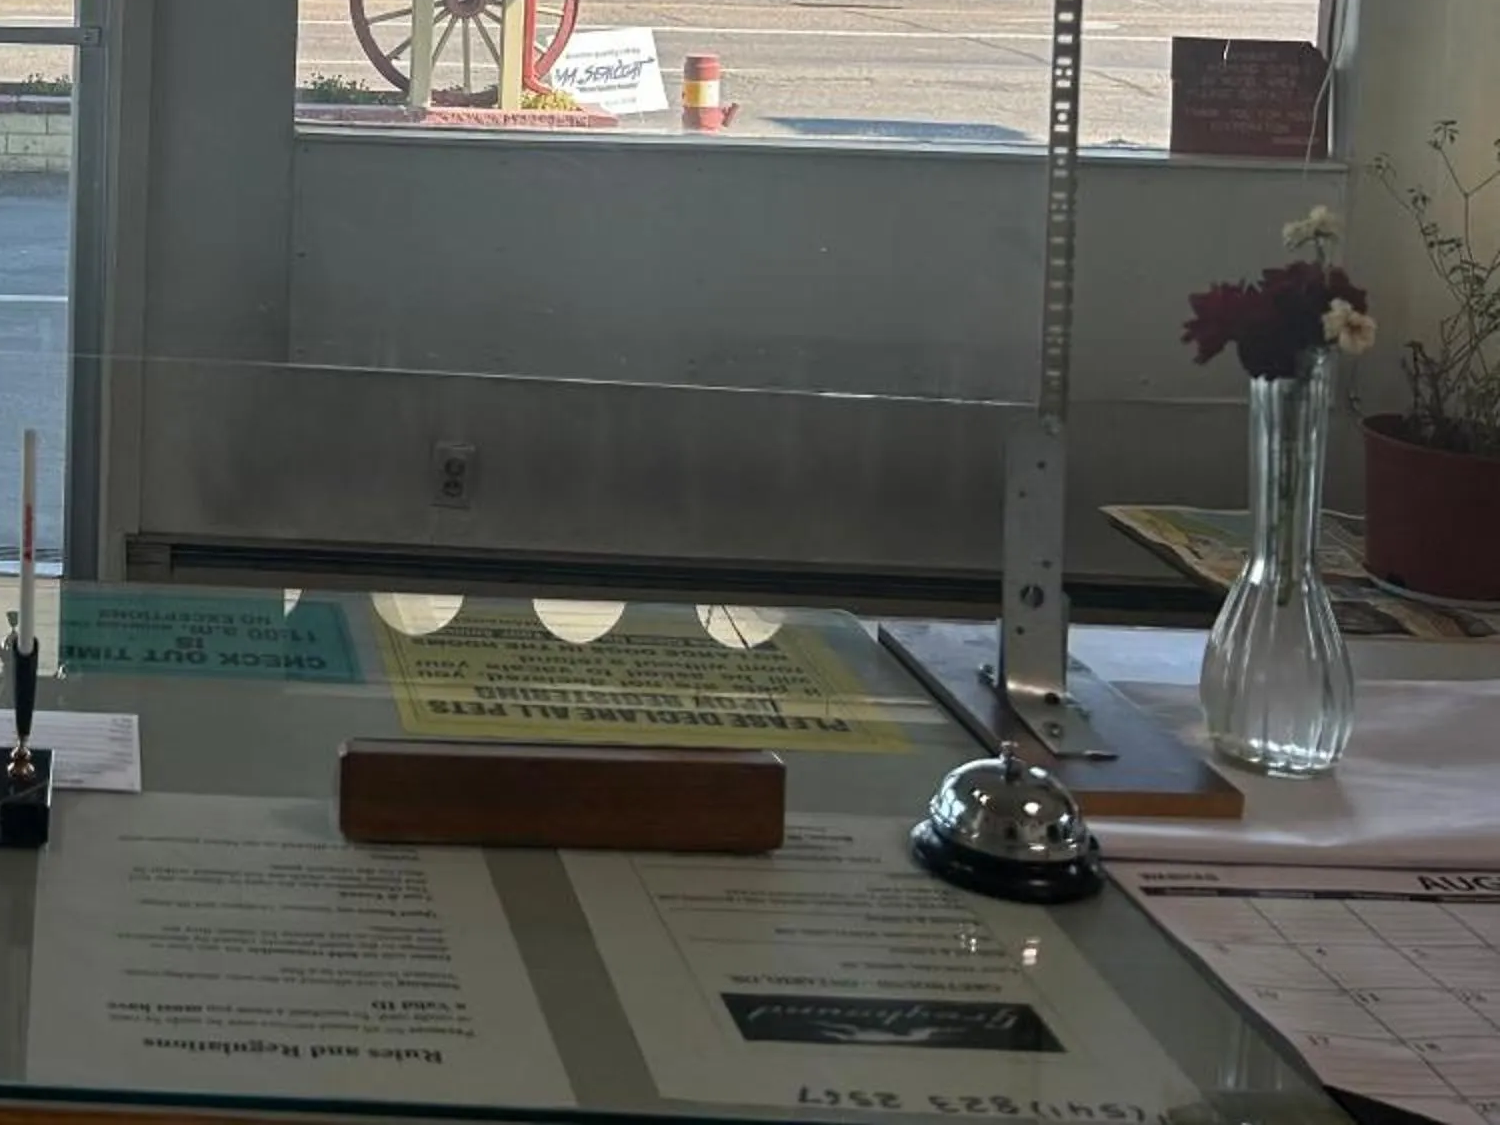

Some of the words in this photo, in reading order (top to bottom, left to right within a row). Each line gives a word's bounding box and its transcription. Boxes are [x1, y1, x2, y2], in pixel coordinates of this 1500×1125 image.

[100, 610, 234, 625] EXCEPTIONS
[242, 615, 270, 625] NO
[176, 637, 204, 650] IS
[248, 628, 316, 643] 11:00
[63, 646, 132, 662] TIME
[144, 650, 207, 665] OUT
[218, 652, 326, 670] CHECK
[474, 686, 682, 708] REGISTERING
[693, 696, 777, 714] UPON
[428, 700, 508, 717] PETS
[510, 704, 570, 720] ALL
[573, 706, 723, 725] DECLARE
[725, 713, 851, 732] PLEASE
[143, 1038, 300, 1059] Regulations
[310, 1045, 359, 1059] and
[368, 1048, 443, 1065] Rules
[798, 1085, 903, 1110] 2567
[928, 1095, 1020, 1116] 823
